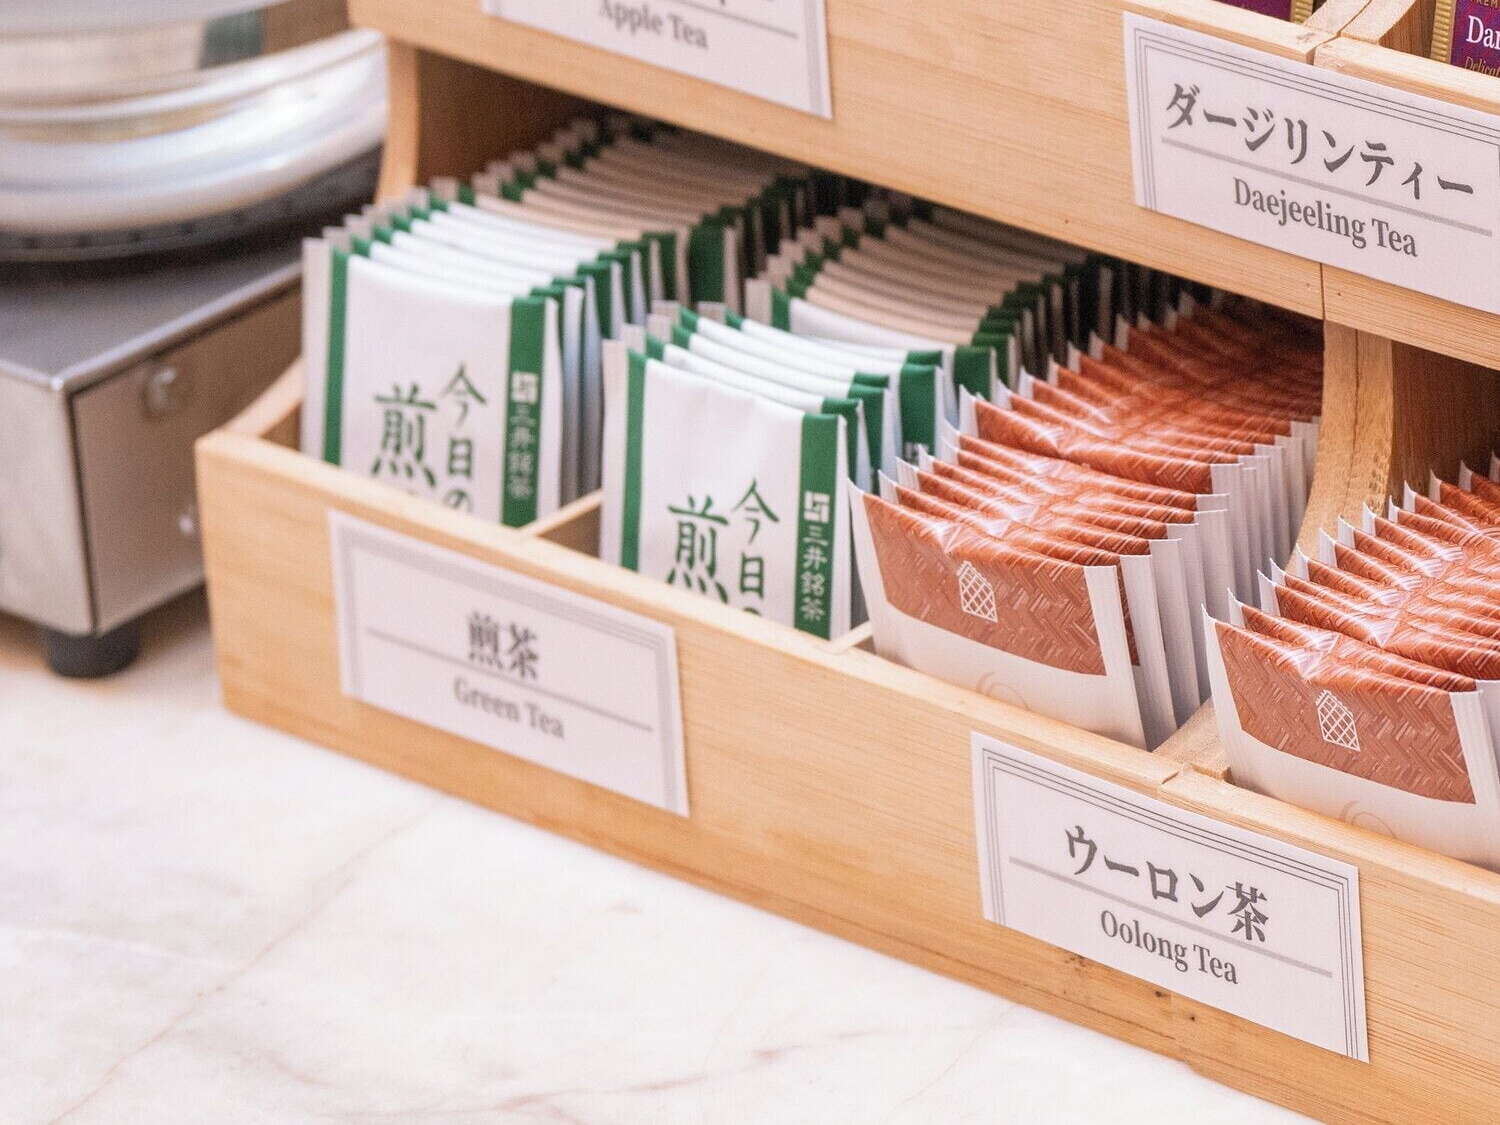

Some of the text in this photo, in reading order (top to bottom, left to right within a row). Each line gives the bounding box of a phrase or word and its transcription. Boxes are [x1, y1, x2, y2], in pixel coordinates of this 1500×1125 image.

[668, 13, 709, 50] Tea
[1165, 82, 1474, 201] ダージリンティー
[1233, 177, 1418, 258] Daejeeling Tea
[370, 381, 438, 496] 煎
[732, 478, 779, 616] 今日
[453, 676, 565, 739] Green Tea
[1064, 825, 1270, 943] ウーロン茶
[1100, 909, 1239, 985] Oolong Tea
